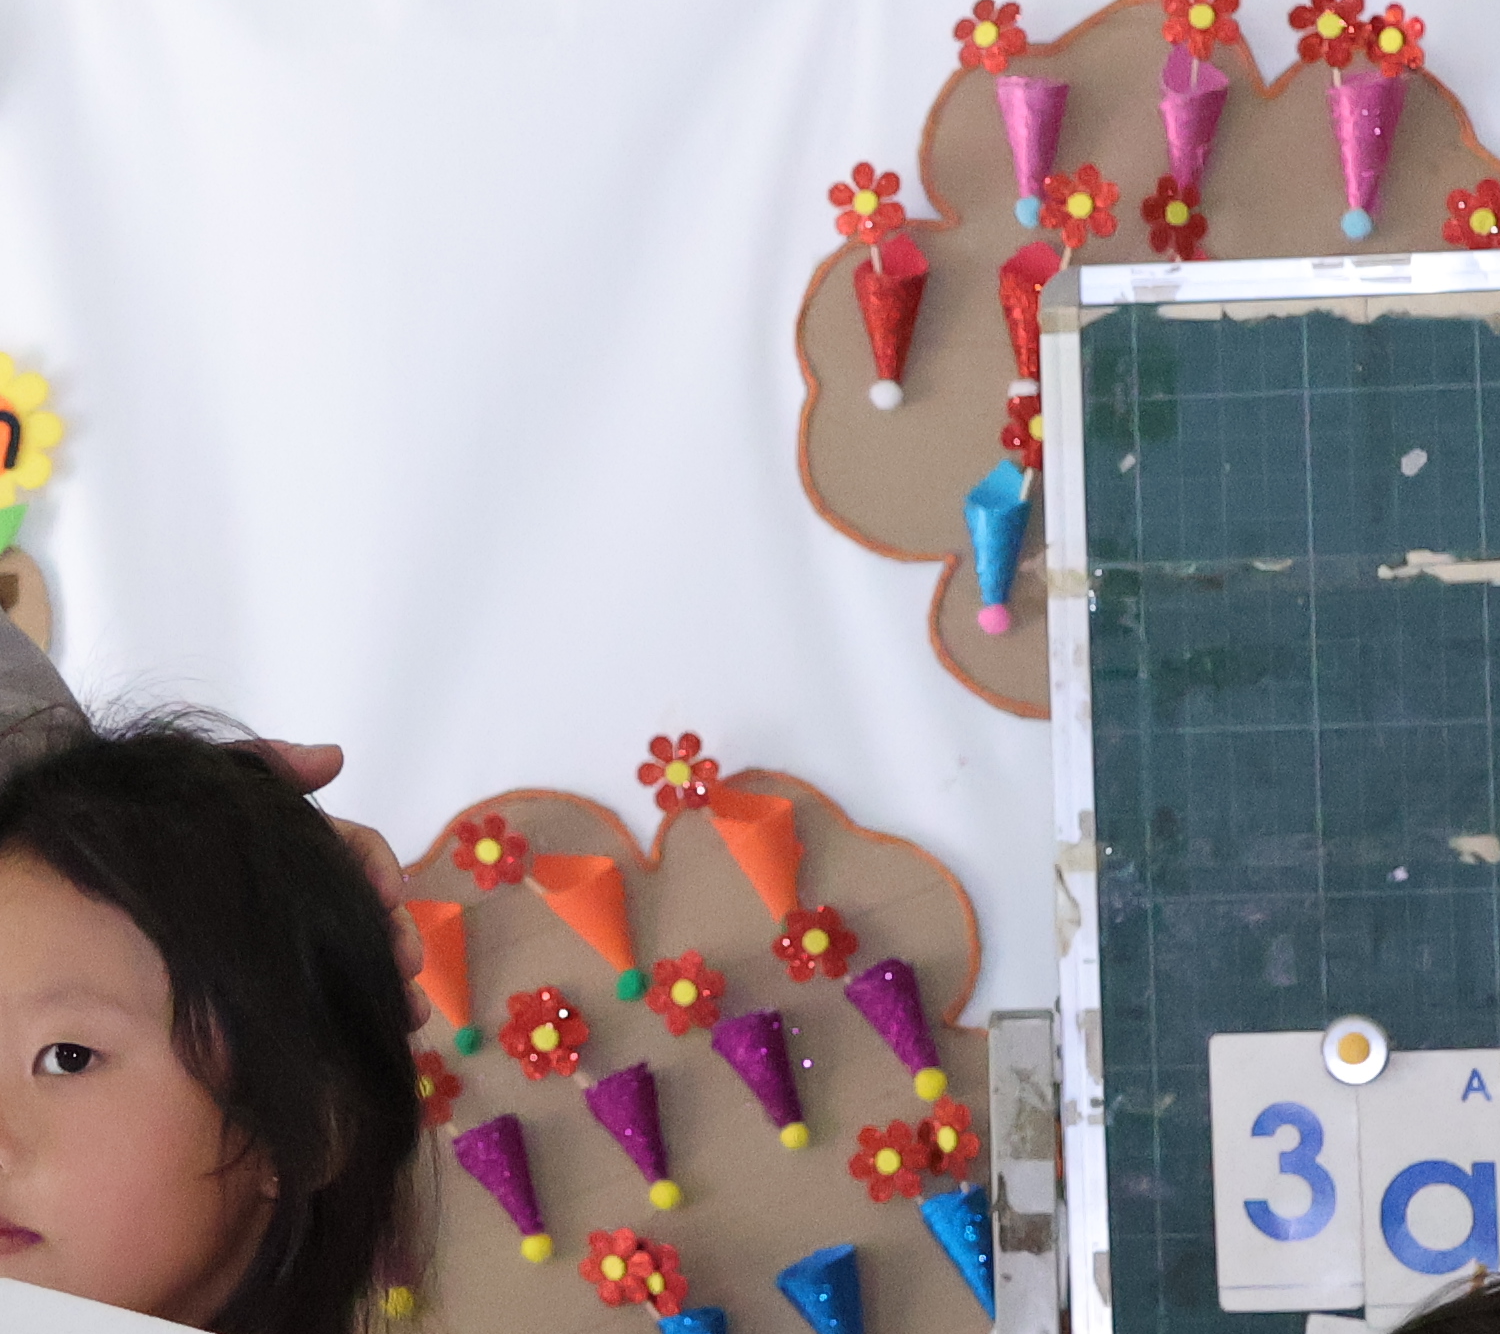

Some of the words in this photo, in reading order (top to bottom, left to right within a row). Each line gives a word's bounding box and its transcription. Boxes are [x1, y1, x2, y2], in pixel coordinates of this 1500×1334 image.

[1462, 1069, 1491, 1101] A
[1244, 1101, 1336, 1242] 3
[1380, 1160, 1496, 1275] a
